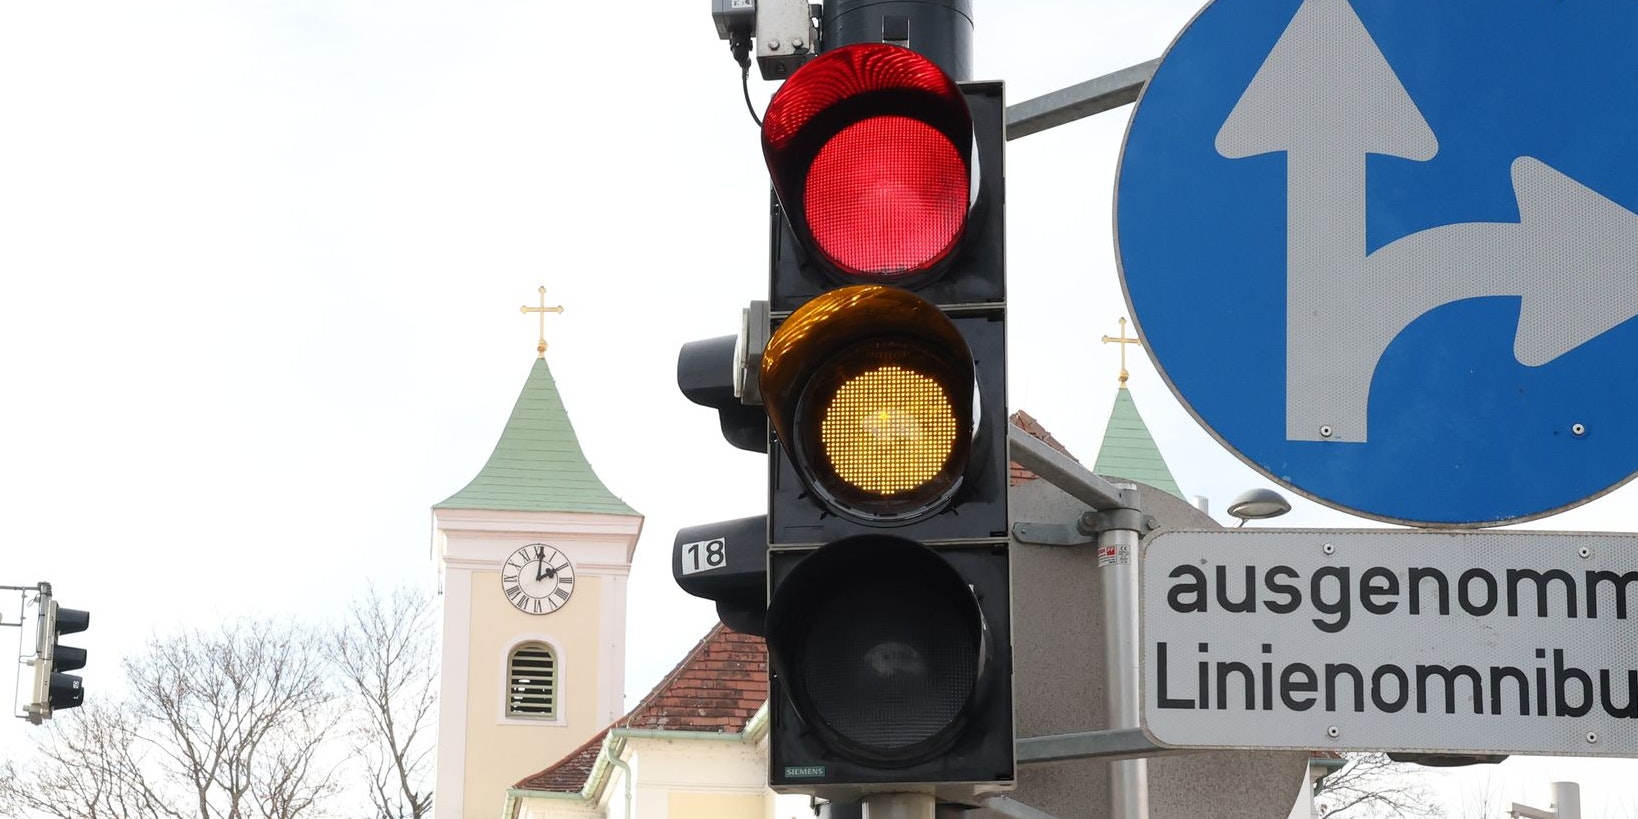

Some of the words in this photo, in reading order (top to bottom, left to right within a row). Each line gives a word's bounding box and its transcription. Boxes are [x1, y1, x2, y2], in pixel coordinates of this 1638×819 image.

[687, 540, 725, 571] 18
[1166, 563, 1638, 633] ausgenomm
[1156, 641, 1638, 719] Linienomnibu
[786, 767, 824, 776] SIEMENS
